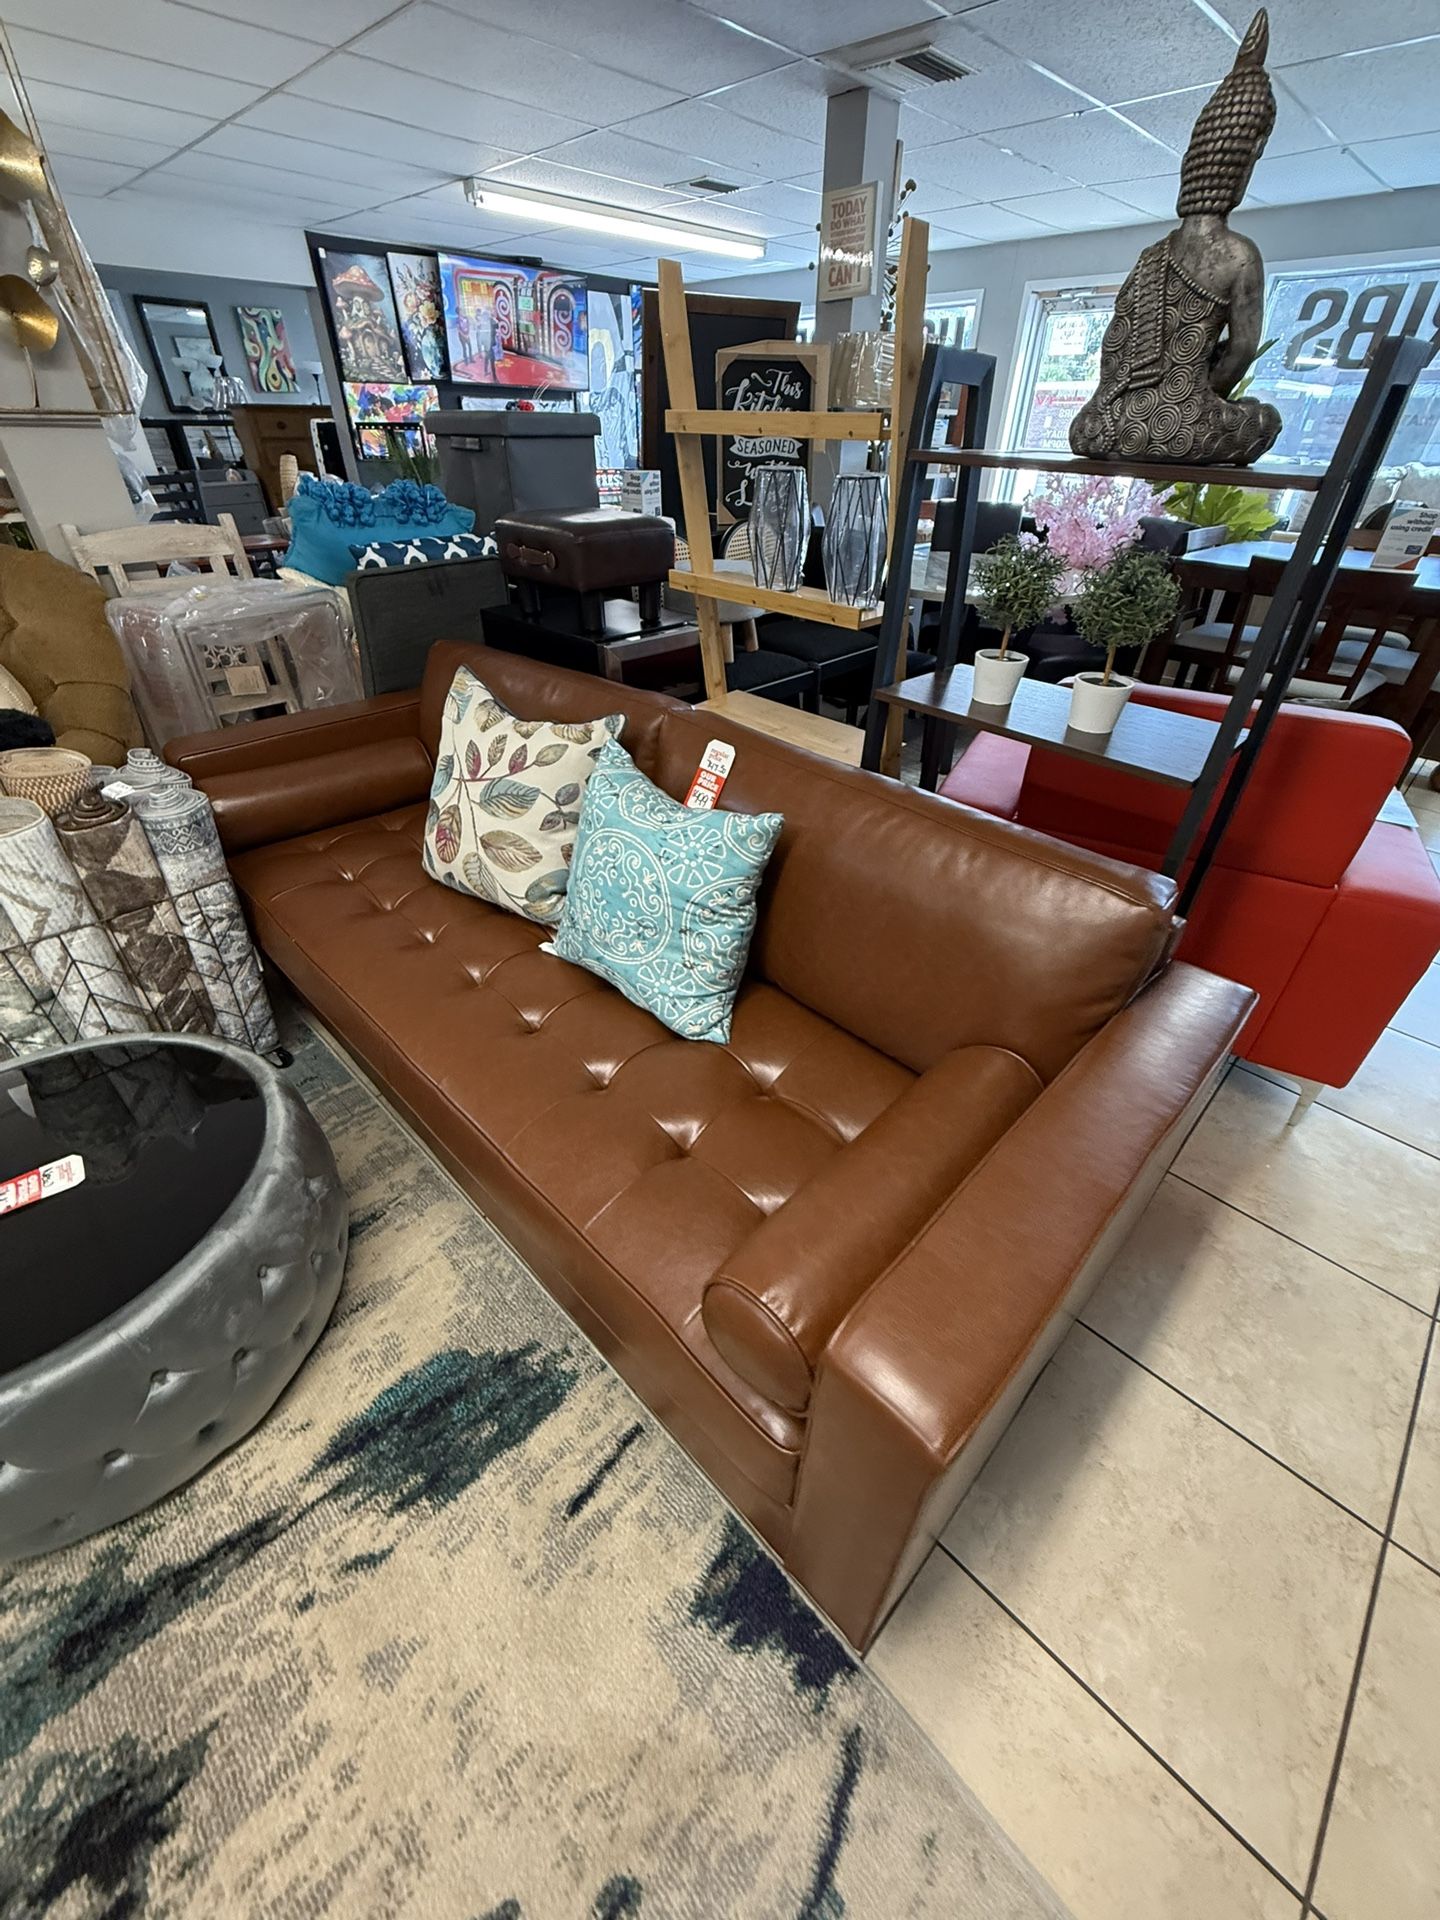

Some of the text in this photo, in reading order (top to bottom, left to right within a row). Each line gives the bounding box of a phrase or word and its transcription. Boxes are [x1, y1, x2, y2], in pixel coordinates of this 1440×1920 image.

[831, 196, 868, 219] TODAY
[830, 214, 866, 231] DO WHAT
[751, 368, 804, 399] This
[725, 378, 800, 412] Kitch
[736, 437, 796, 455] SEASONED
[1419, 511, 1439, 519] Shop
[697, 776, 720, 792] PRICE
[700, 770, 718, 783] OUR
